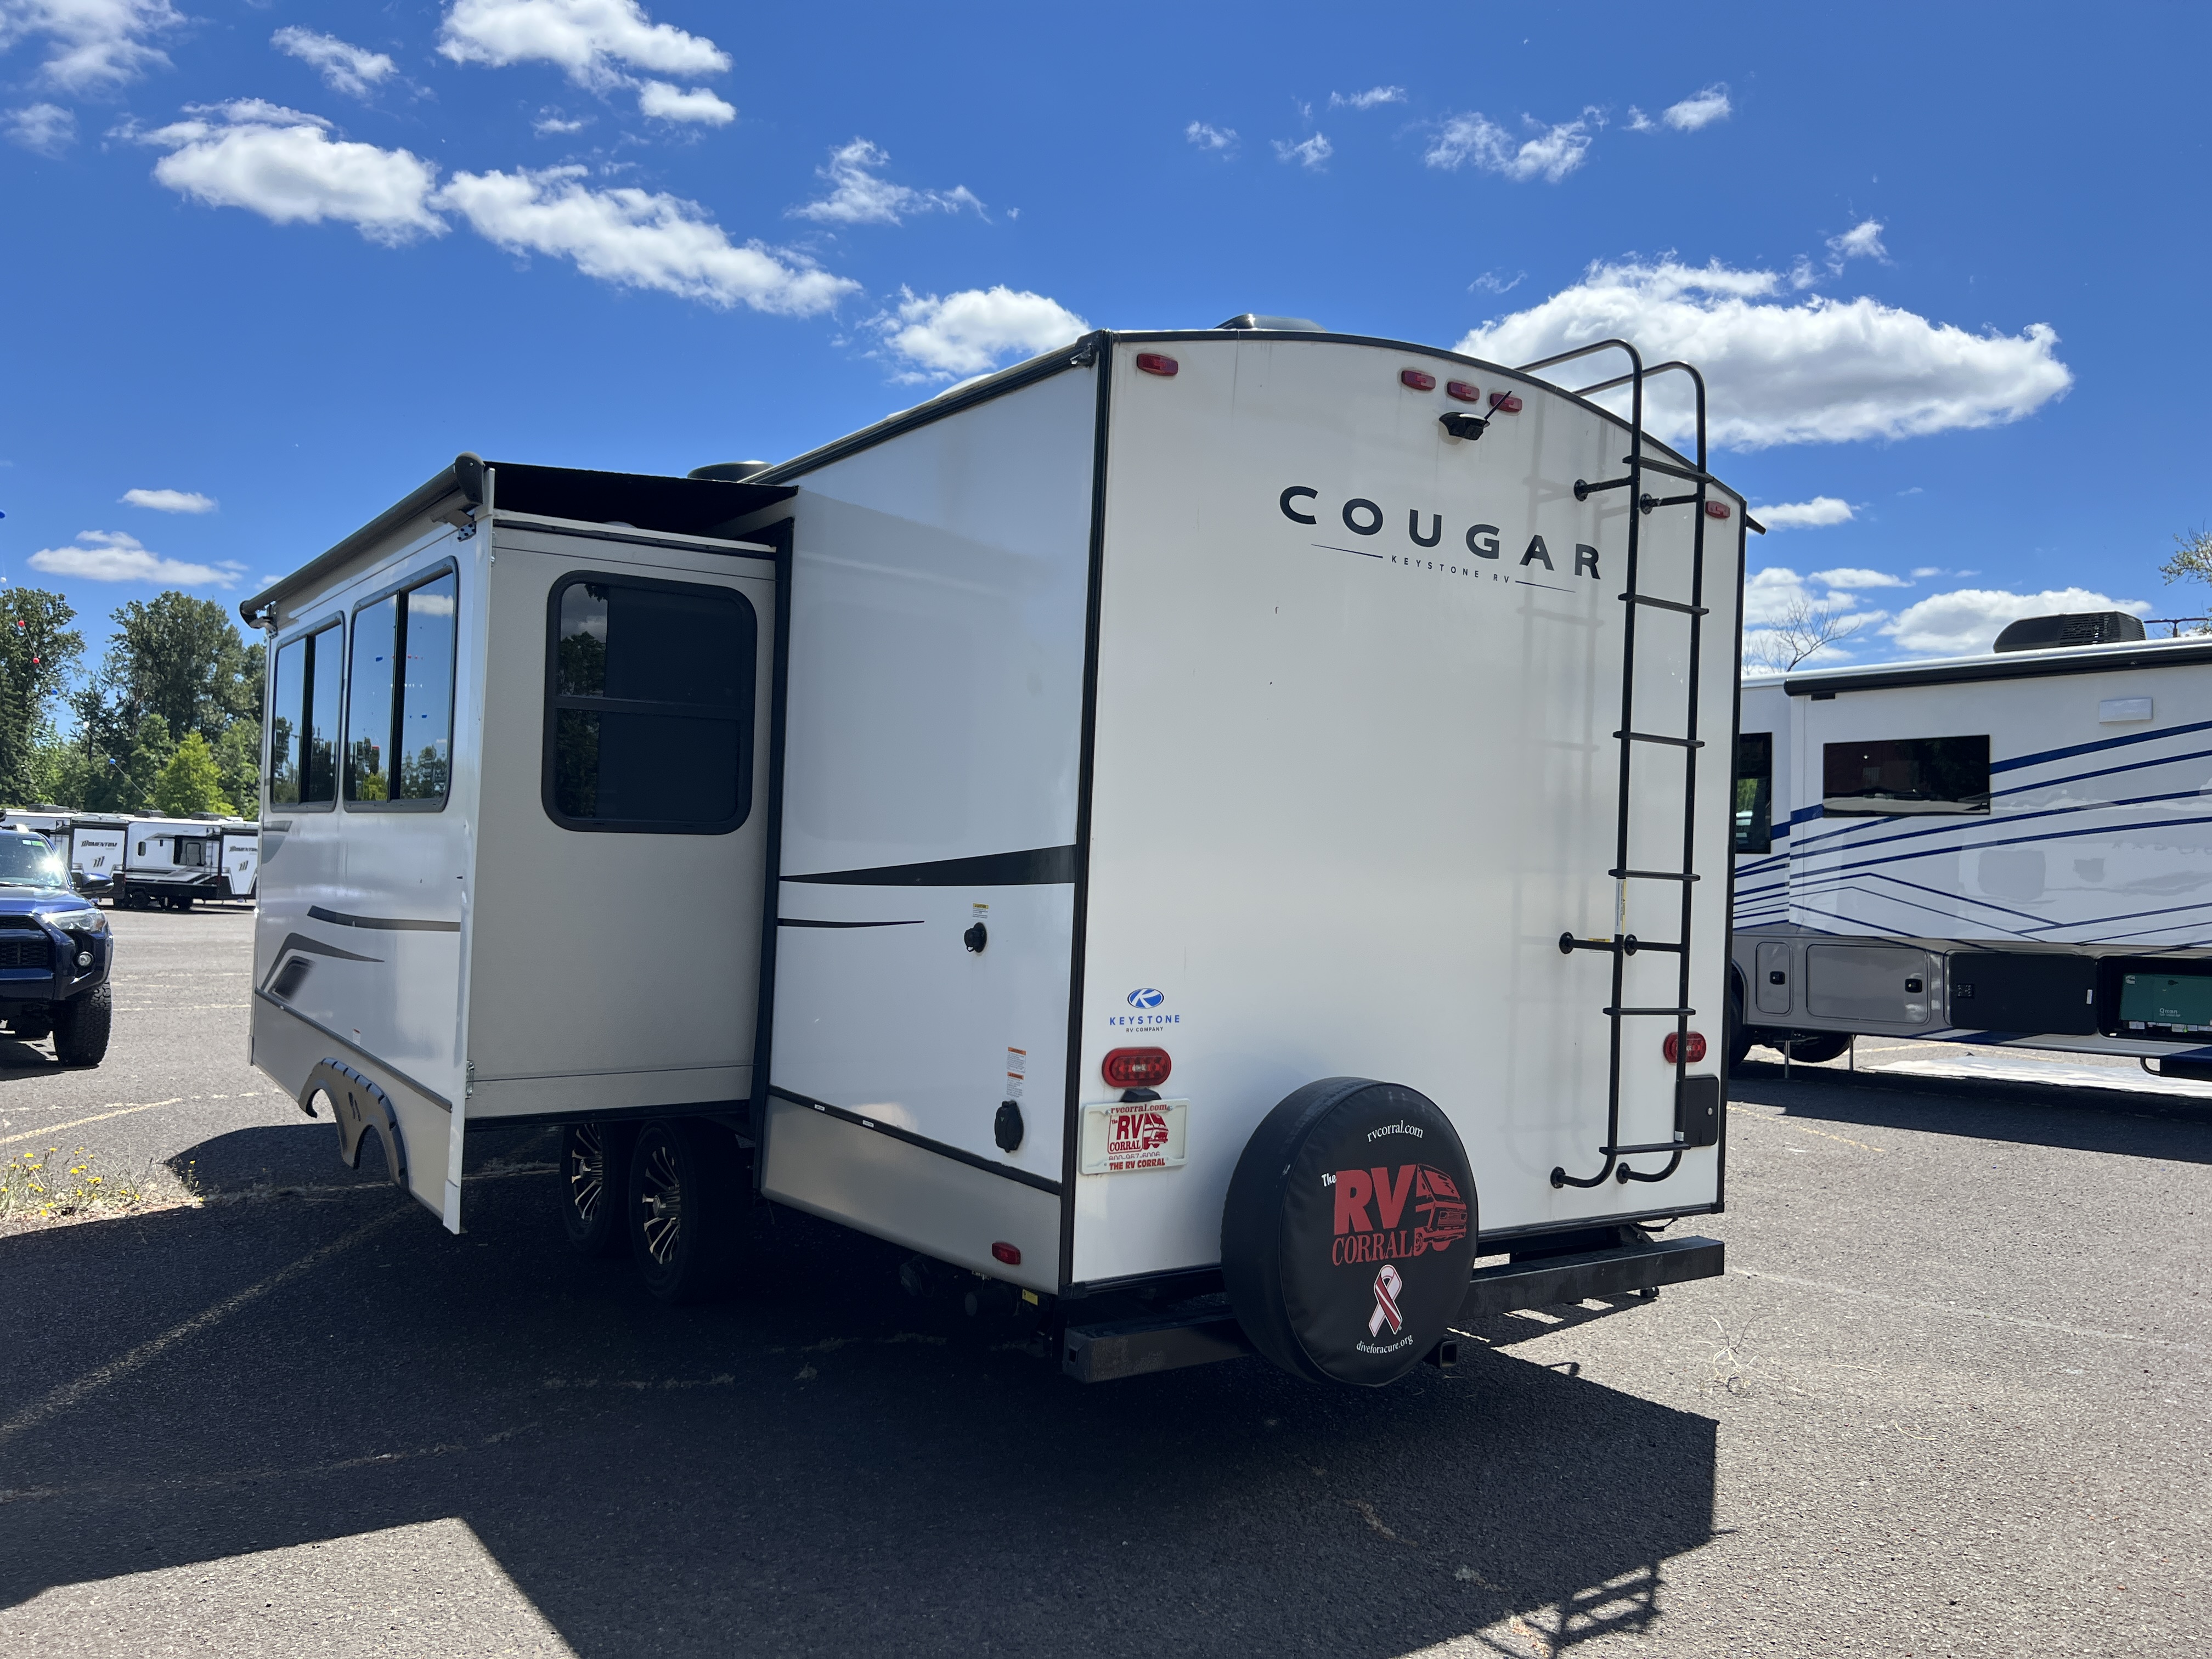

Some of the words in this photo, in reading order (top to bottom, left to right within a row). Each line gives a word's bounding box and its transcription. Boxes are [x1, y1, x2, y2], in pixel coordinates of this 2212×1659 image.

[1279, 486, 1601, 580] COUGAR
[1391, 555, 1479, 578] KEYSTONE
[1493, 574, 1509, 583] RV
[1109, 1014, 1180, 1026] KEYSTONE
[1111, 1104, 1167, 1114] rvcorral.com
[1116, 1114, 1144, 1140] RV
[1367, 1120, 1424, 1143] rvcorral.com
[1109, 1140, 1141, 1152] CORRAL
[1109, 1161, 1124, 1171] THE
[1125, 1160, 1136, 1169] RV
[1137, 1158, 1165, 1168] CORRAL
[1321, 1173, 1337, 1187] The
[1334, 1164, 1417, 1235] RV
[1331, 1231, 1413, 1266] CORRAL
[1356, 1334, 1413, 1354] diveforacure.org
